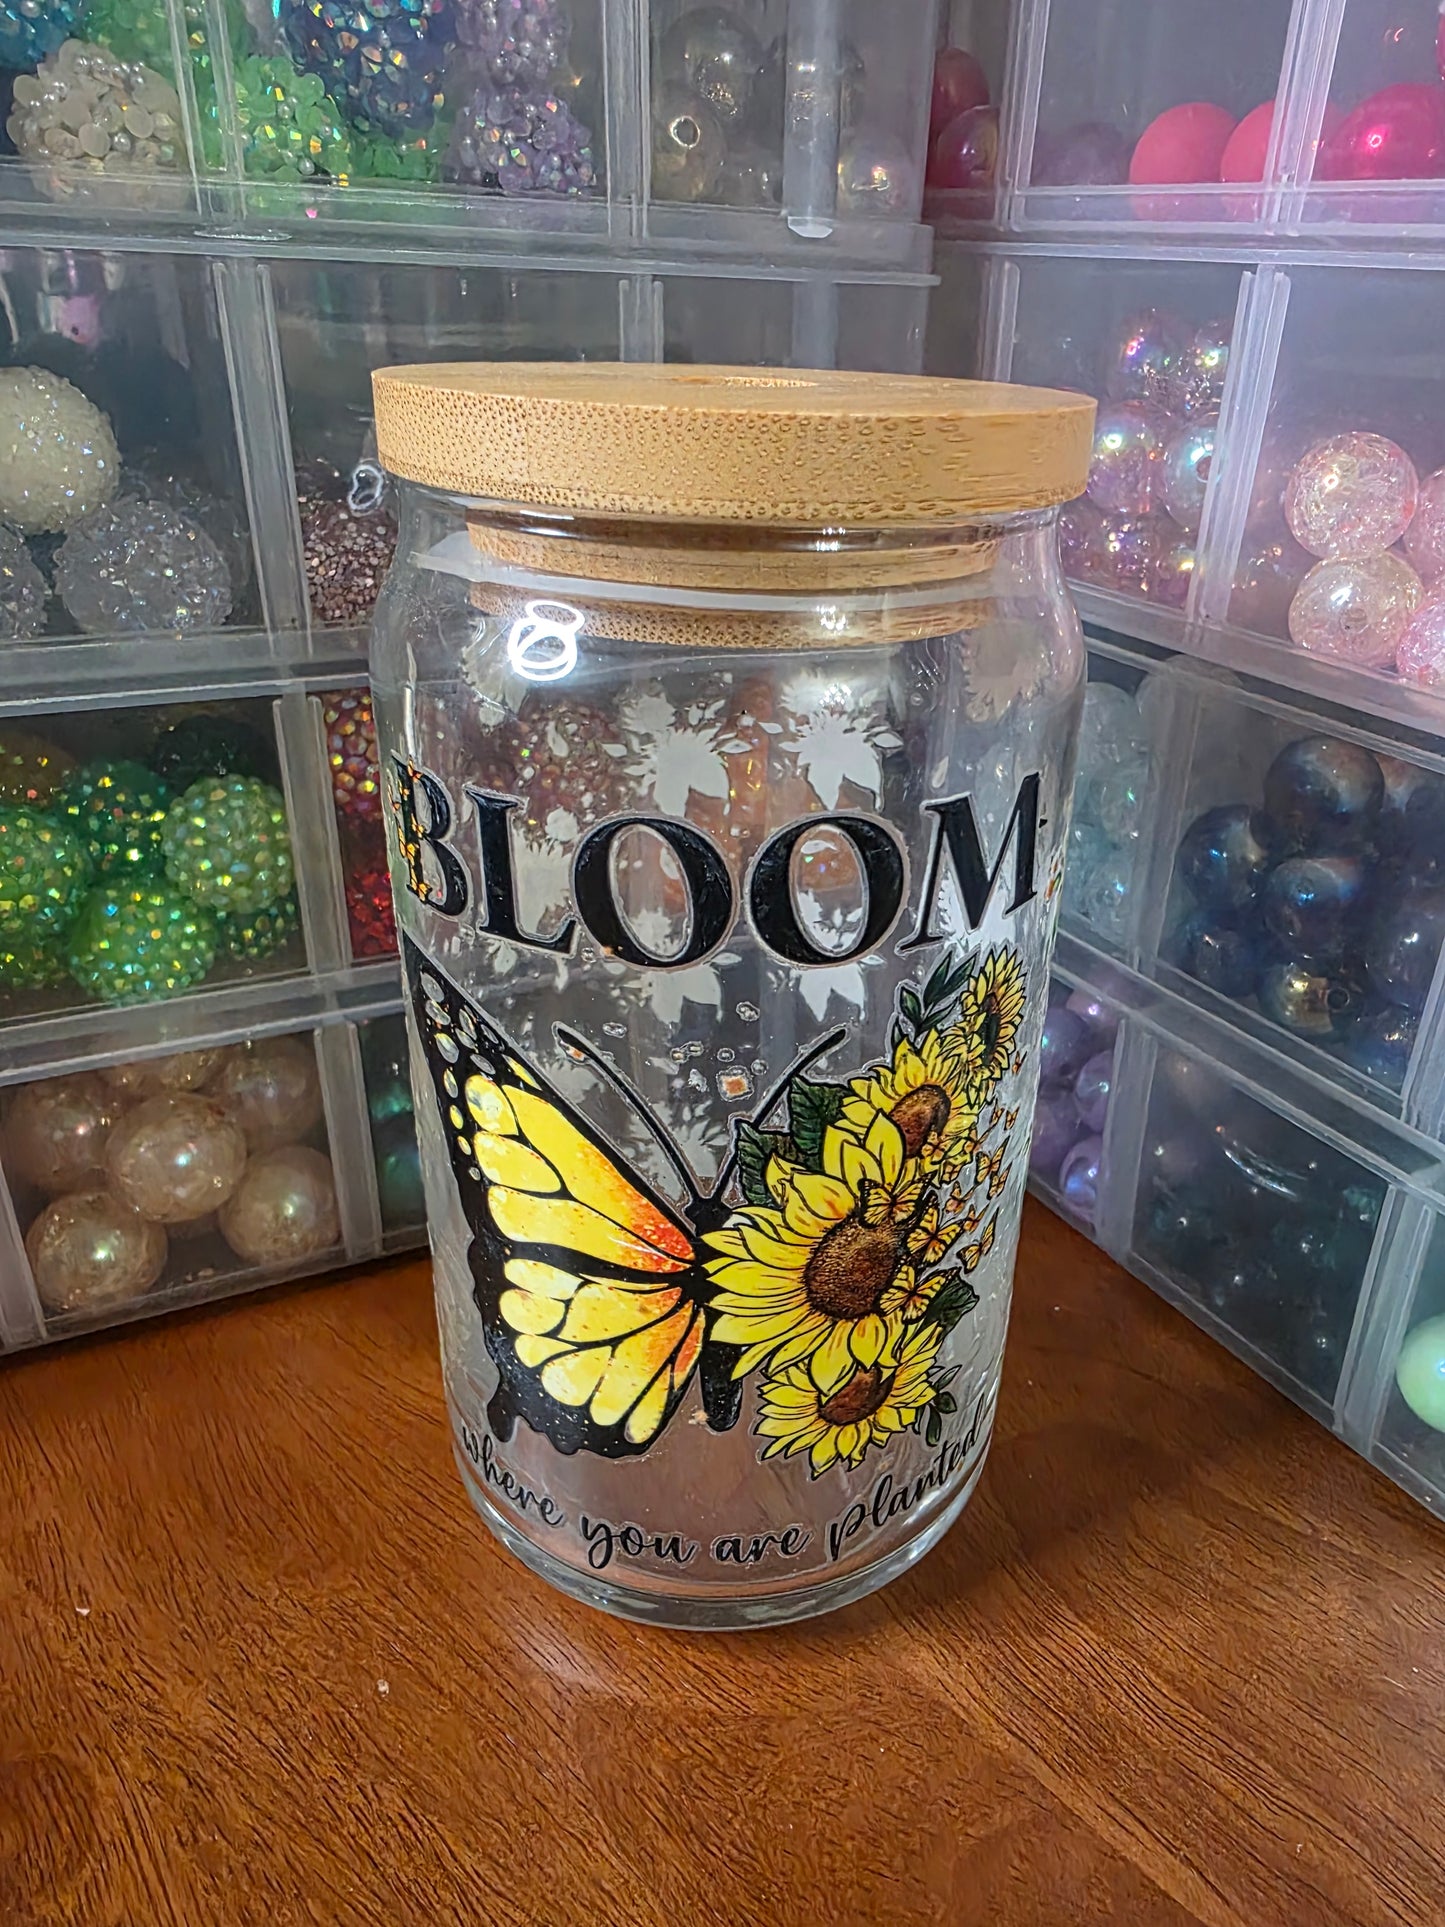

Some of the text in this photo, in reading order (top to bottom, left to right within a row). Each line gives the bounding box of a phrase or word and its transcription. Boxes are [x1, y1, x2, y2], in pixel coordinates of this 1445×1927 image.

[391, 754, 1044, 968] BLOOM
[461, 1393, 985, 1569] where you are planted
